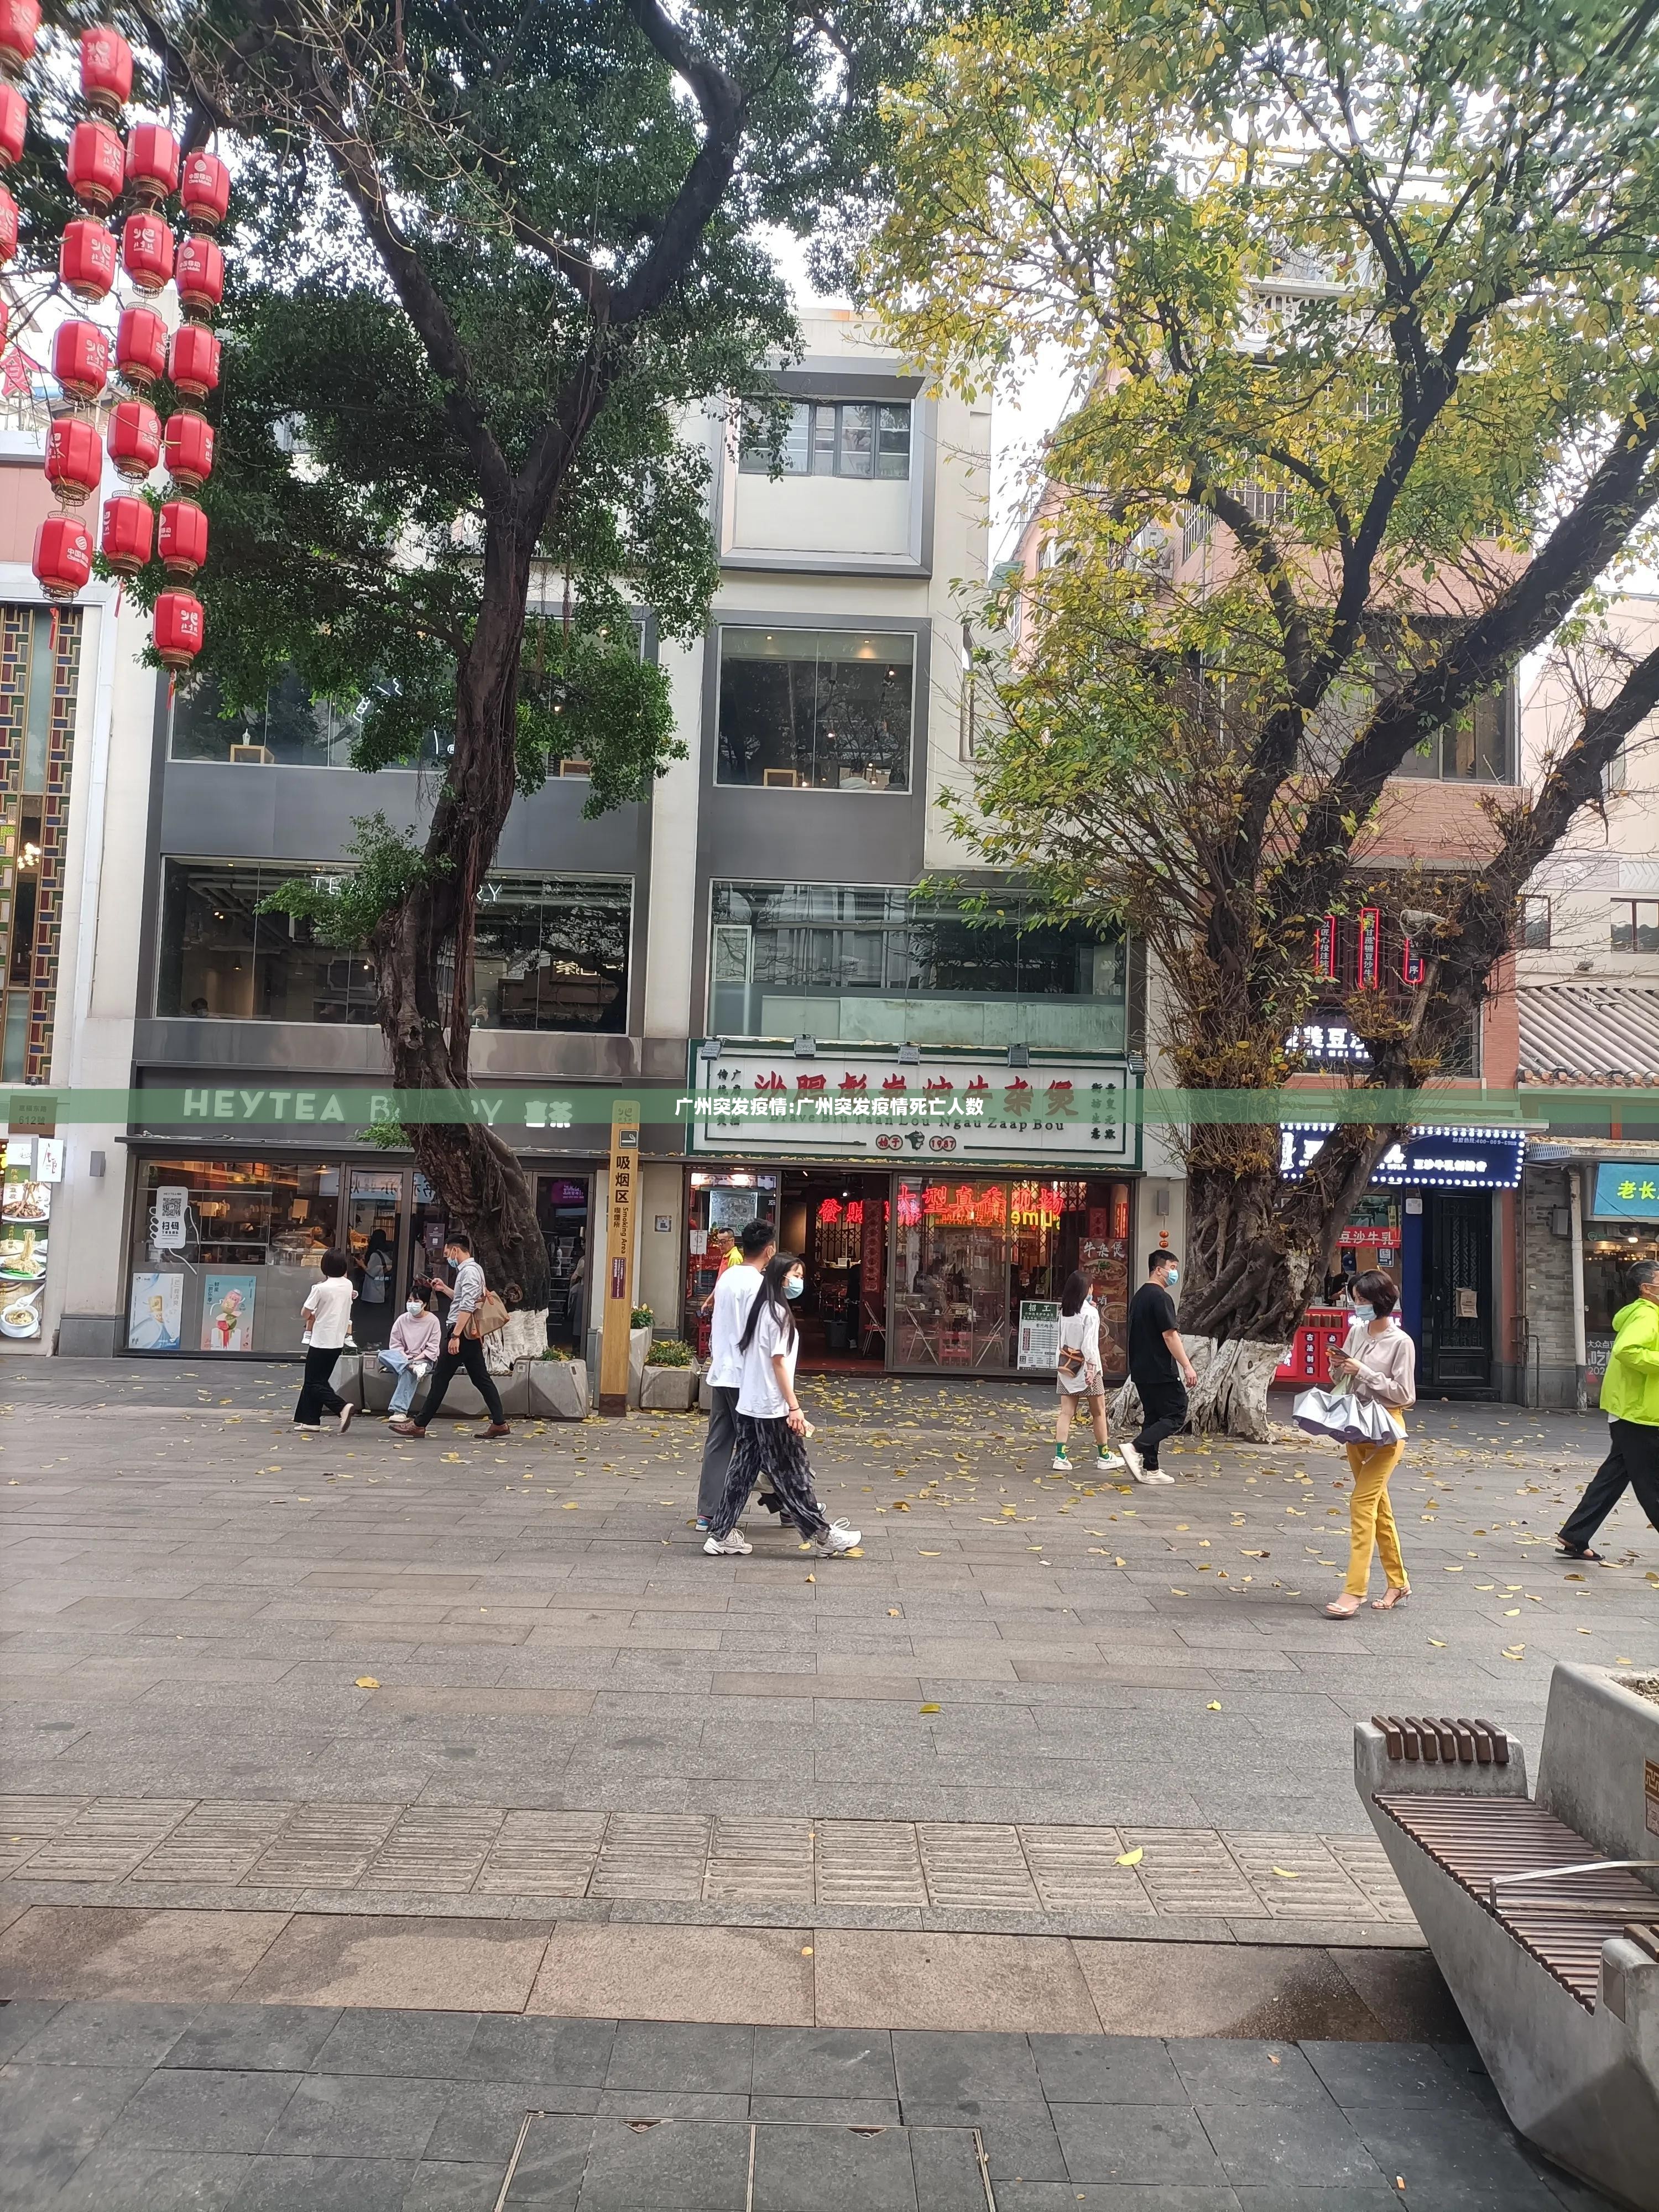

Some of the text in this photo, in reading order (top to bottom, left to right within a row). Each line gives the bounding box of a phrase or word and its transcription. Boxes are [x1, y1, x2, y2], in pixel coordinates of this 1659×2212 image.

[184, 1089, 345, 1121] HEYTEA
[939, 1115, 982, 1130] Ngau
[987, 1117, 1028, 1132] Zaap
[1032, 1118, 1065, 1131] Bou
[931, 1140, 954, 1148] 1987
[615, 1156, 630, 1203] 吸烟区
[1617, 1180, 1659, 1200] 老长
[162, 1221, 179, 1230] 扫码
[620, 1207, 629, 1237] Smoking
[1339, 1230, 1394, 1245] 豆沙牛乳
[1083, 1241, 1125, 1258] 牛杂煲
[1588, 1366, 1605, 1375] 202
